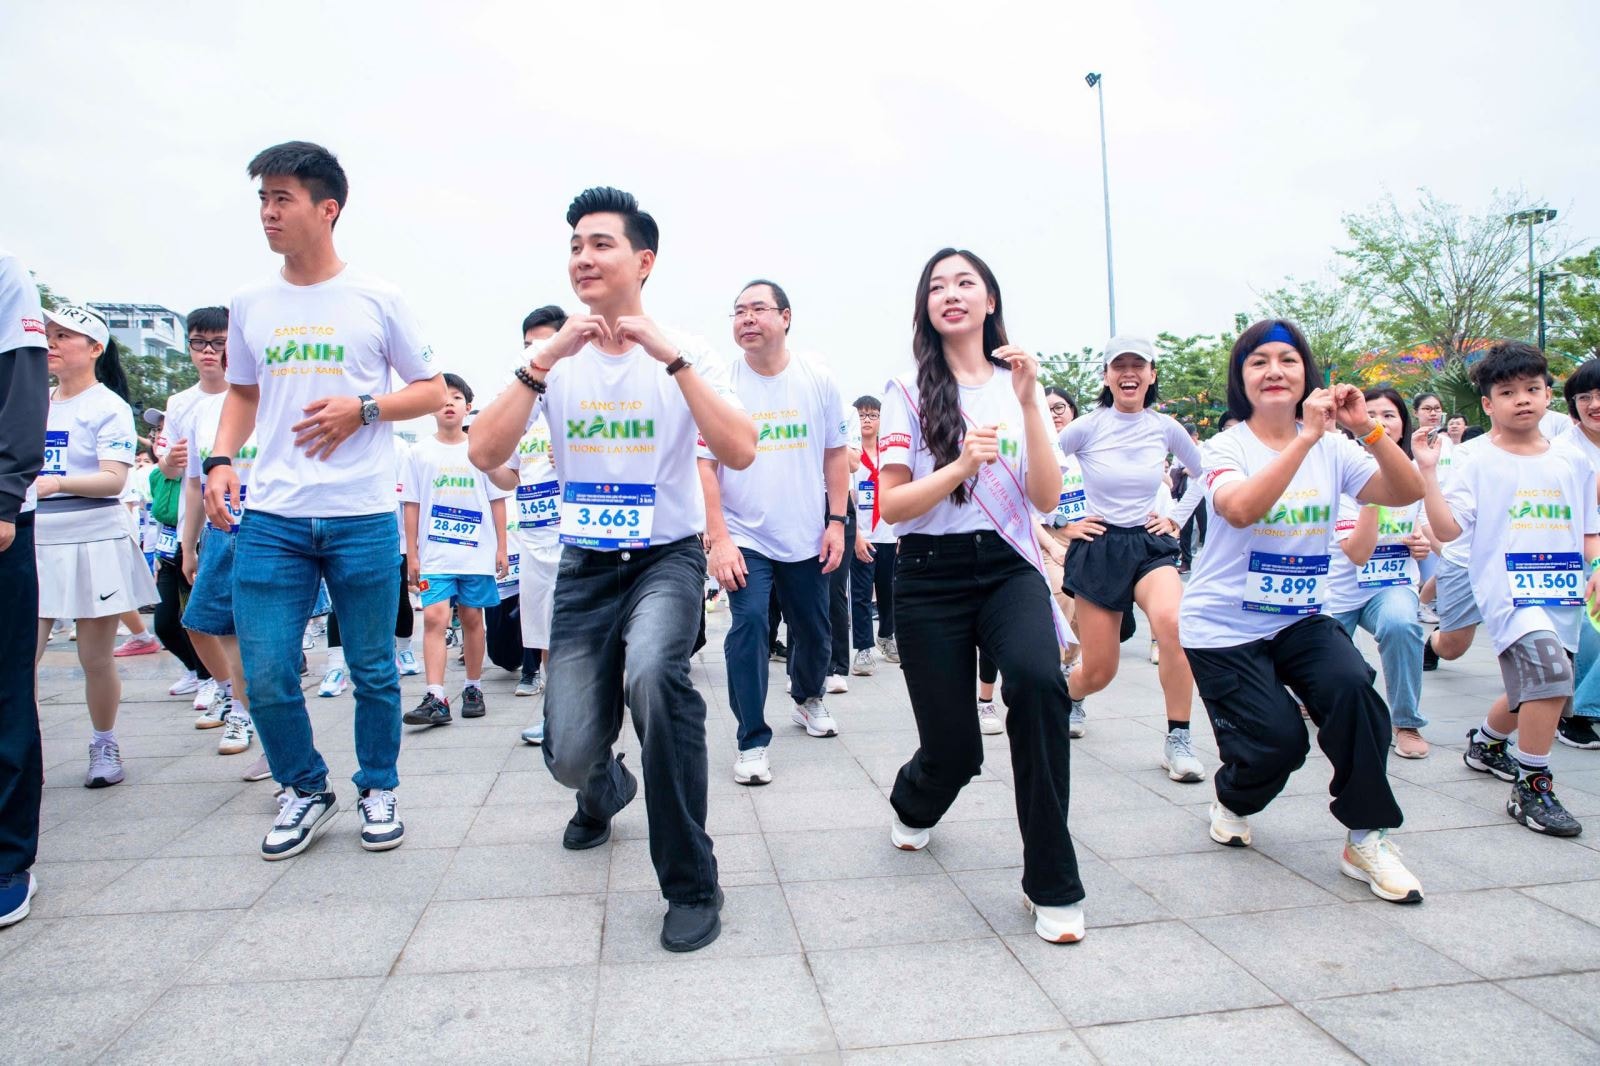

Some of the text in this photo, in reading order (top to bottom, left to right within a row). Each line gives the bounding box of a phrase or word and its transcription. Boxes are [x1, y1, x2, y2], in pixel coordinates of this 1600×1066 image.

[759, 422, 808, 440] ANH
[520, 499, 557, 515] 3.654
[577, 508, 640, 527] 3.663
[434, 519, 477, 535] 28.497
[1361, 559, 1407, 575] 21.457
[1260, 576, 1317, 595] 3.899
[1514, 573, 1578, 589] 21.560
